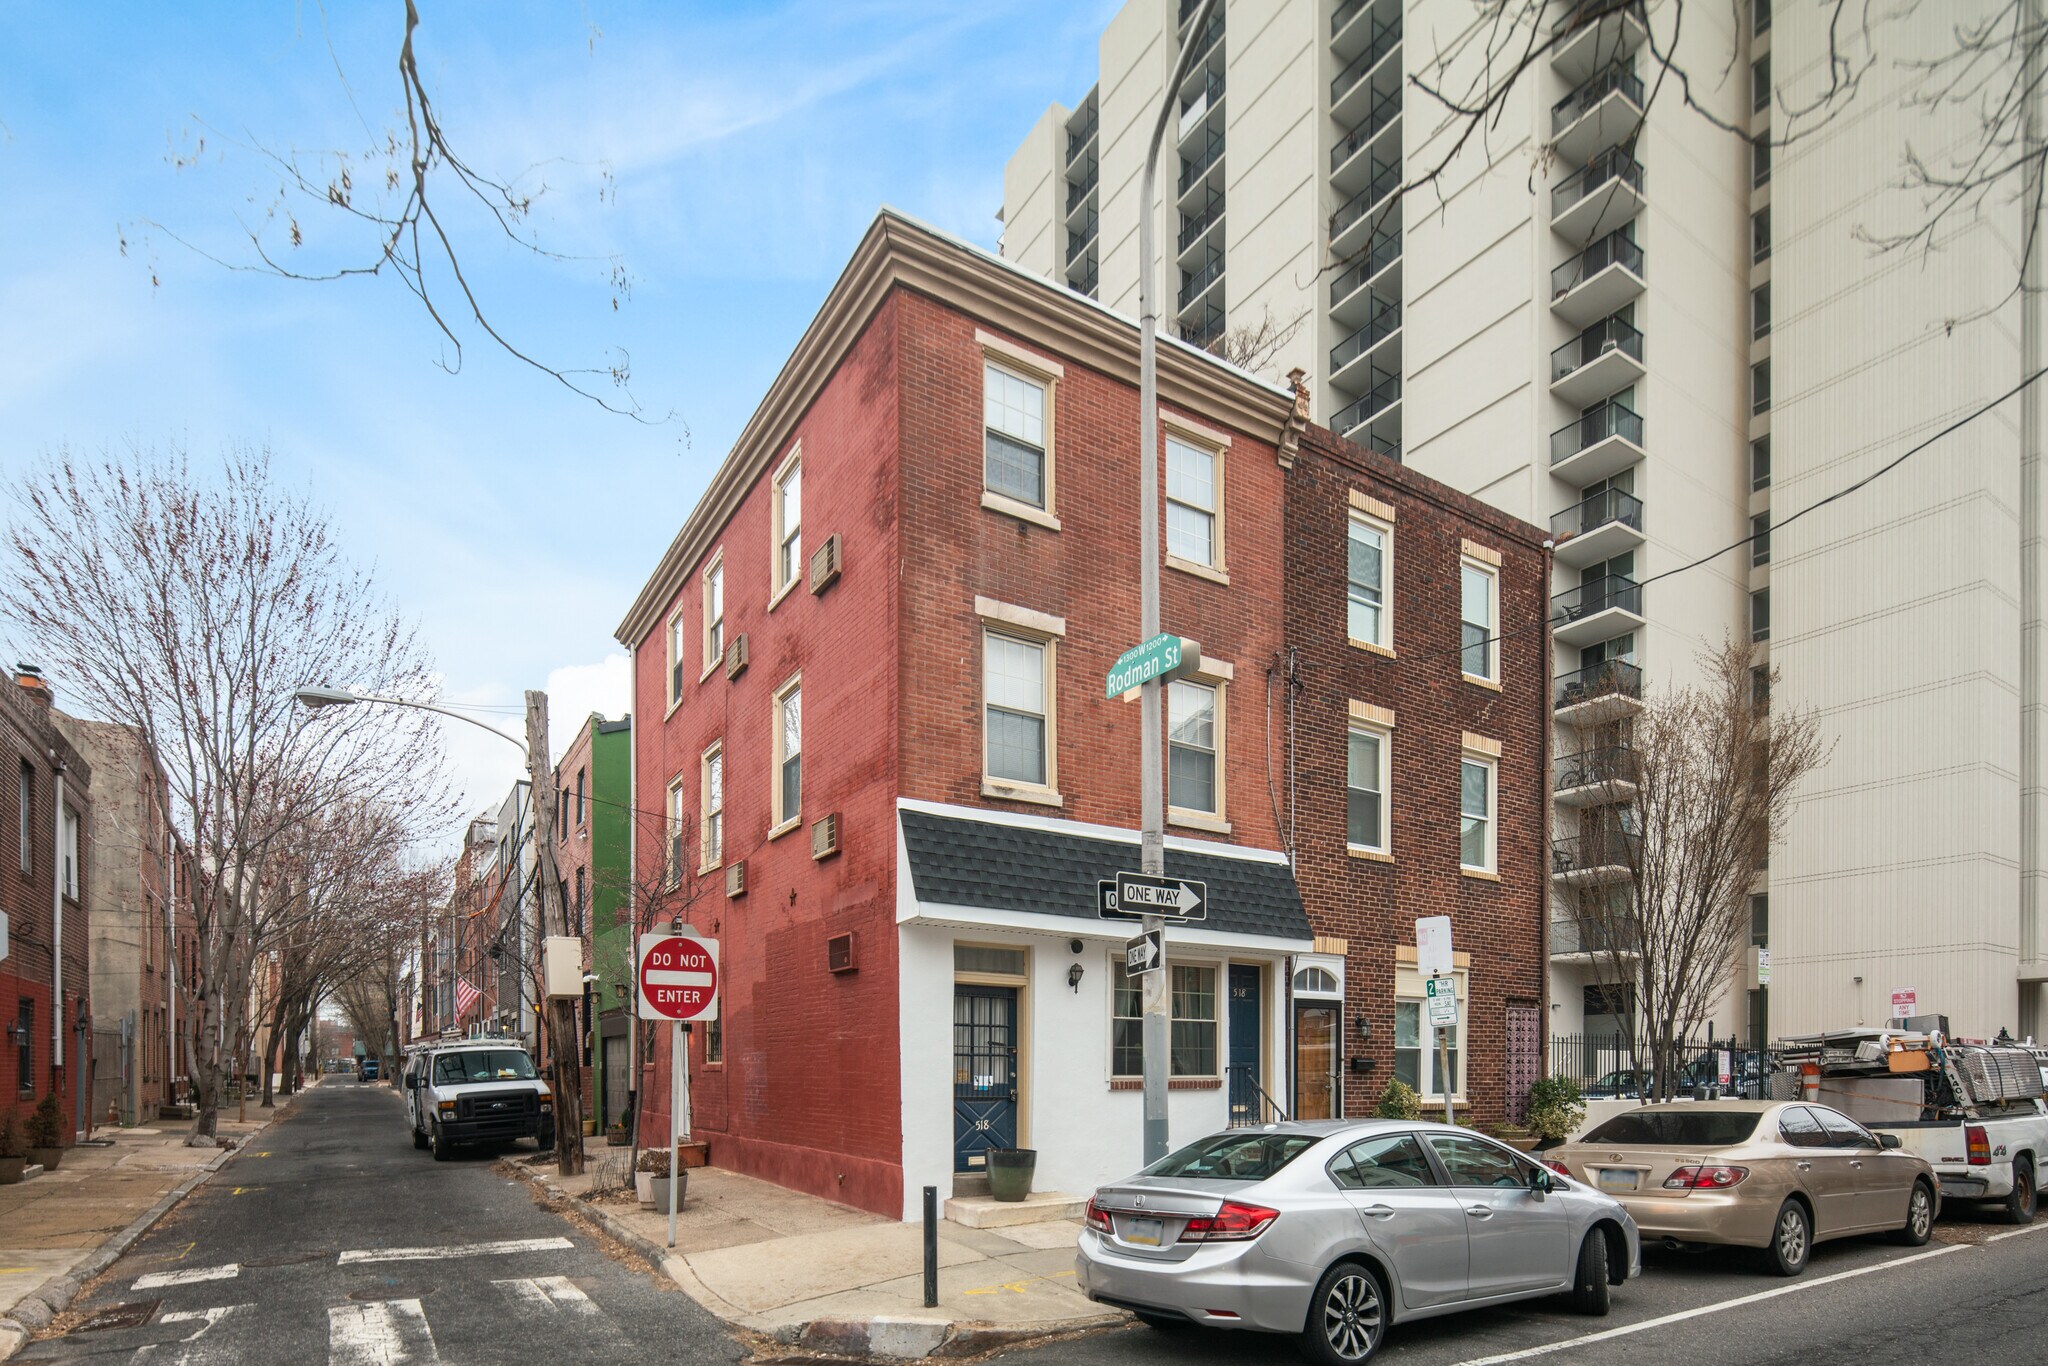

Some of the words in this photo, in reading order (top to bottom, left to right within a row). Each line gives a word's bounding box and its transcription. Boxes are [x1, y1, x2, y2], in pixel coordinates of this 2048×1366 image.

[1123, 649, 1138, 663] 1300
[1138, 644, 1146, 656] W
[1146, 638, 1161, 651] 1200
[1108, 656, 1159, 696] Rodman
[1165, 645, 1178, 668] St
[1127, 885, 1151, 902] ONE
[1156, 888, 1180, 905] WAY
[653, 952, 671, 966] DO
[680, 954, 706, 968] NOT
[1129, 948, 1137, 965] ONE
[657, 989, 701, 1003] ENTER
[1233, 988, 1246, 998] 518
[1428, 982, 1435, 995] 2
[975, 1119, 989, 1131] 518
